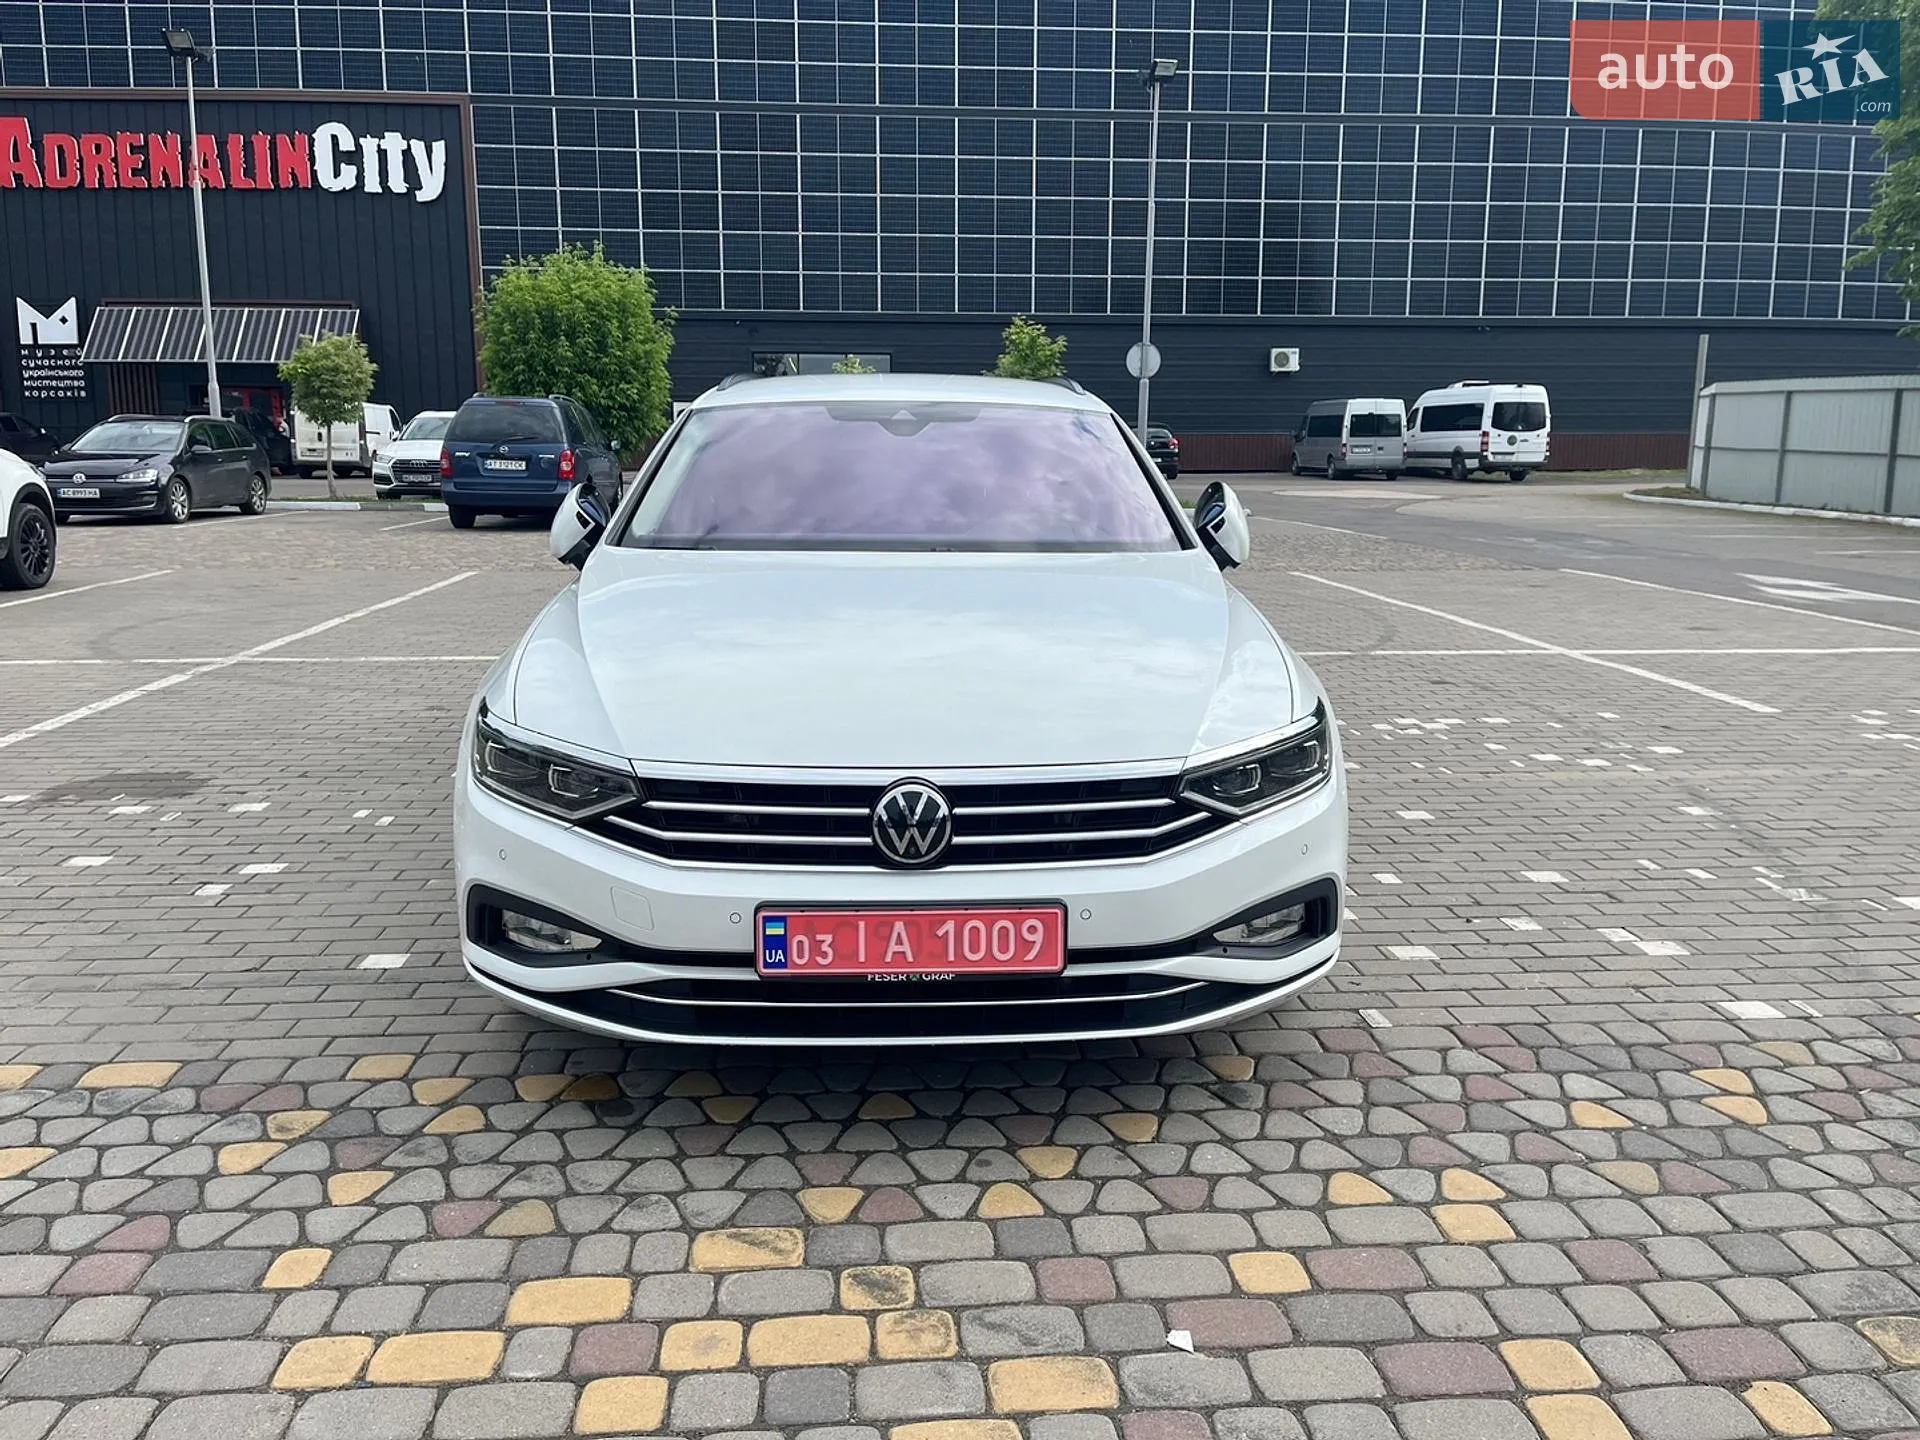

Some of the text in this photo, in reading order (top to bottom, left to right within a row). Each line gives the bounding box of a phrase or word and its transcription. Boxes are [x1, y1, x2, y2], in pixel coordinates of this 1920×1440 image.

[765, 949, 785, 963] UA
[791, 933, 834, 966] 03
[935, 918, 1045, 962] 1009
